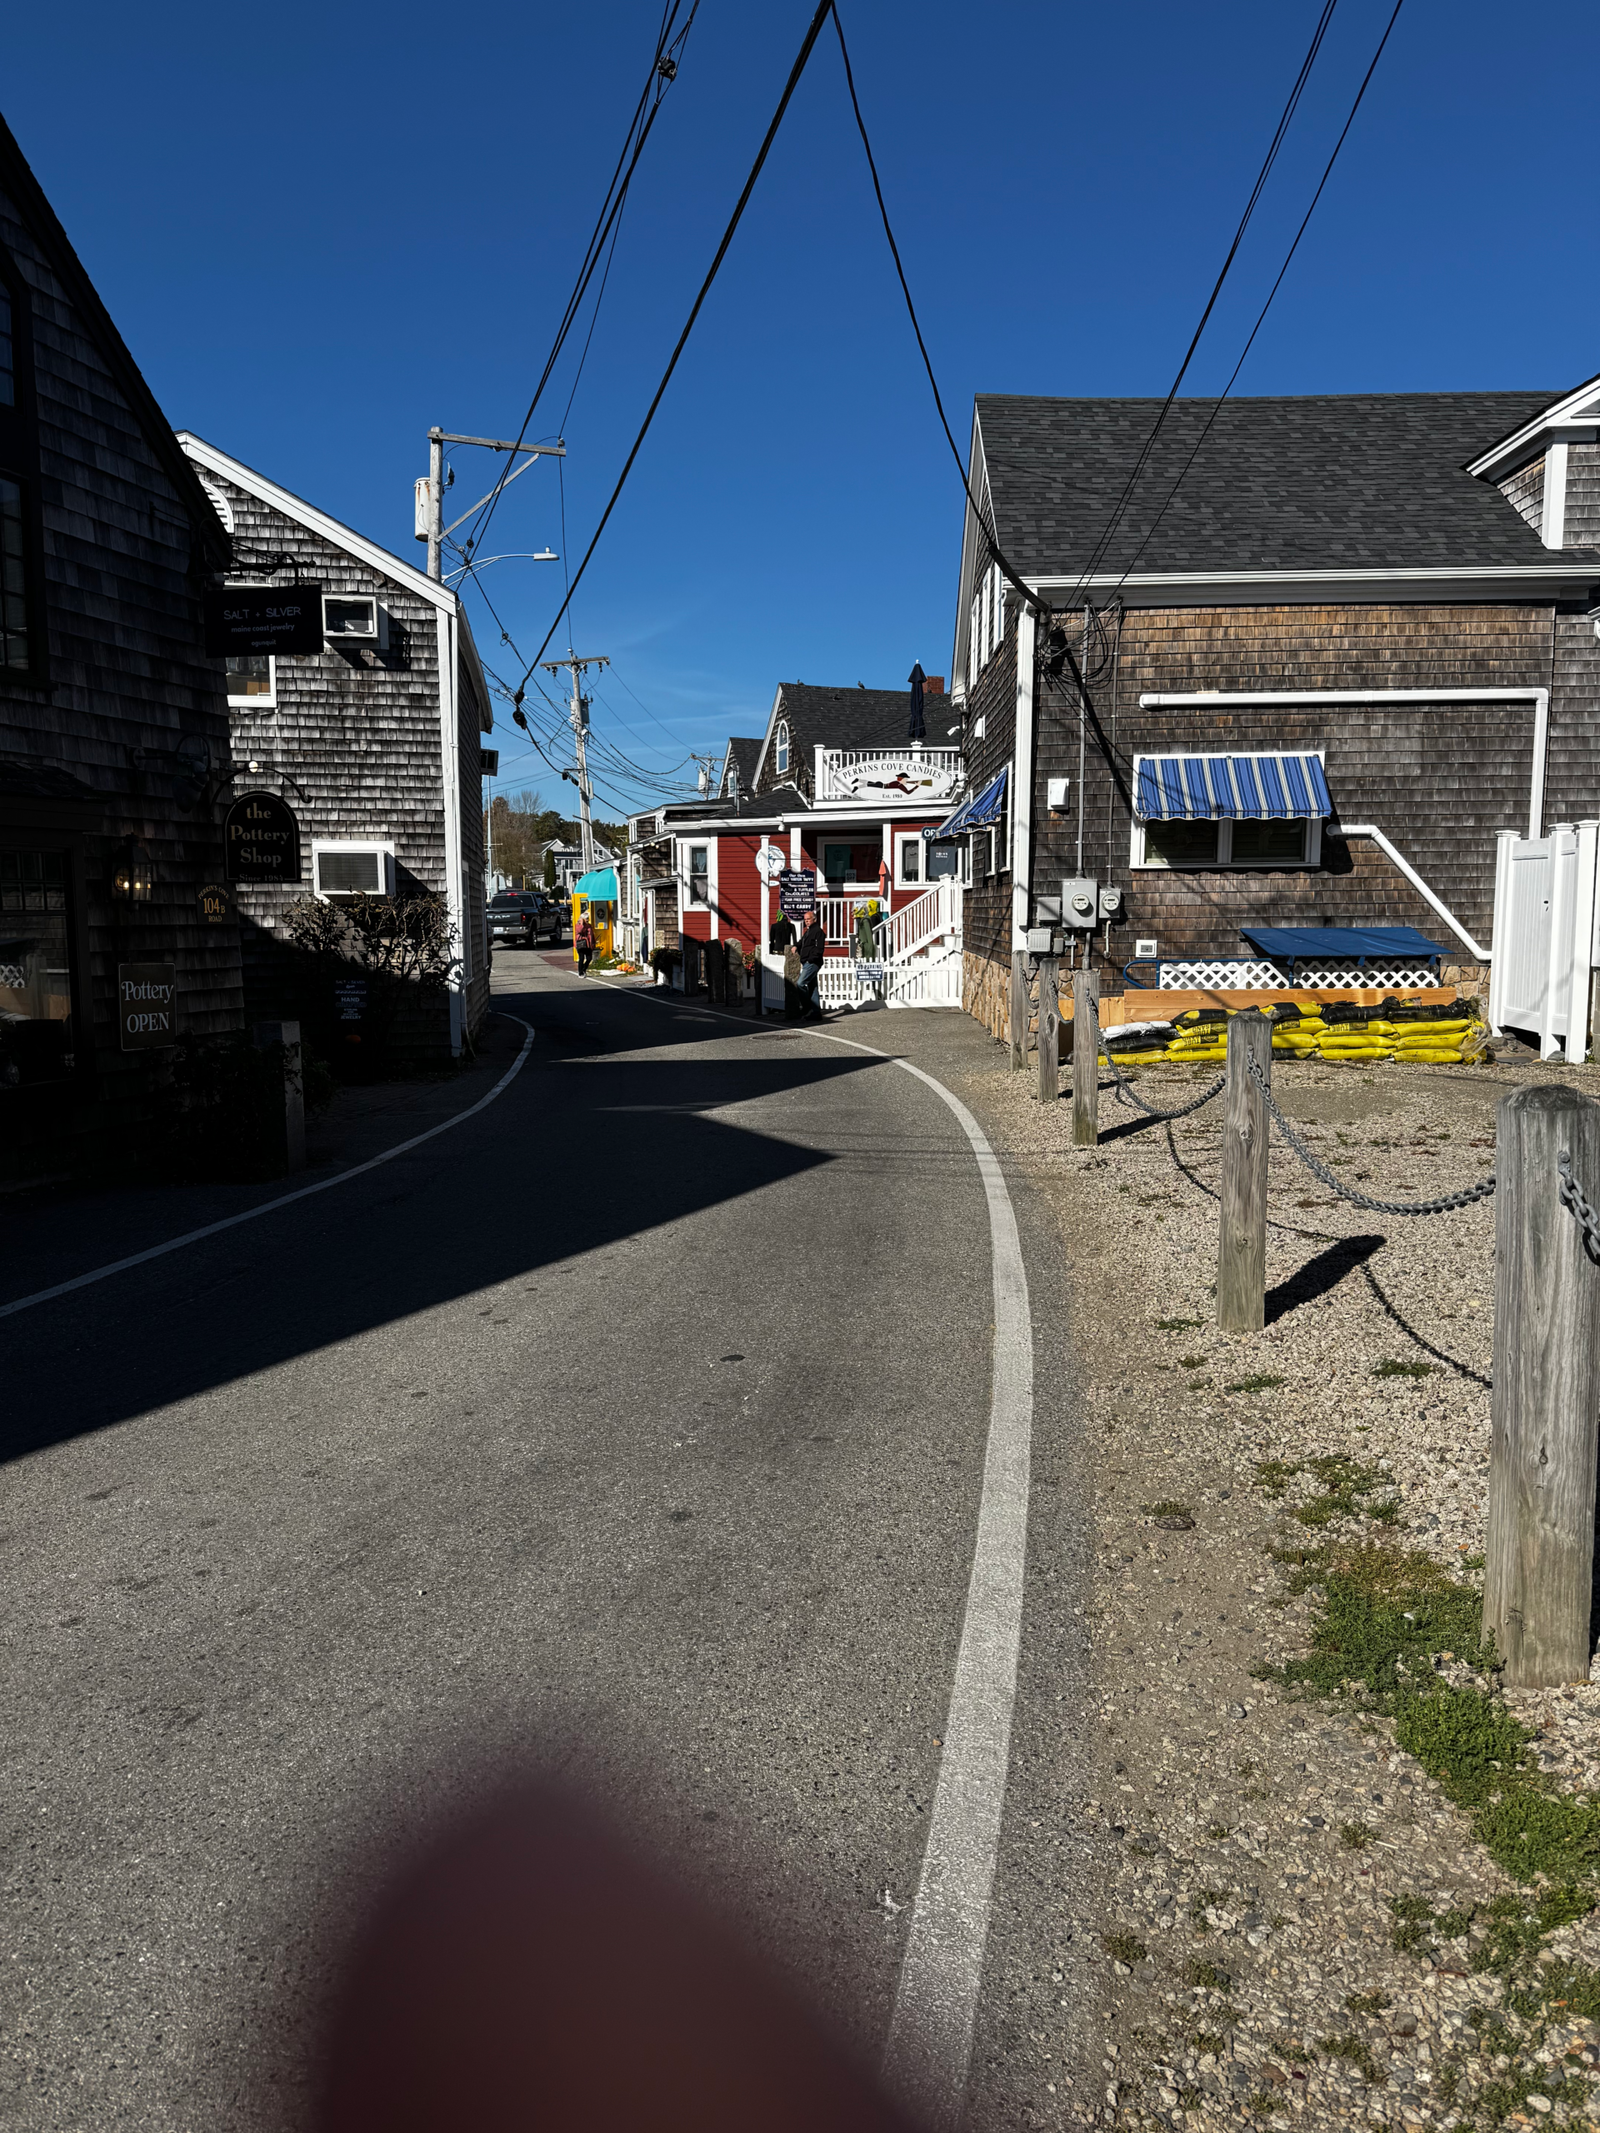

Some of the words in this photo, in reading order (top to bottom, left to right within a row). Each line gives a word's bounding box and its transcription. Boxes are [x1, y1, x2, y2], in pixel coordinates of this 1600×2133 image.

[223, 608, 250, 620] SALT
[265, 605, 302, 618] SILVER
[231, 625, 251, 633] maine
[252, 624, 270, 632] coast
[270, 622, 295, 633] jewelry
[251, 639, 277, 648] ogunquit
[842, 764, 879, 779] PERKINS
[881, 763, 904, 771] COVE
[906, 764, 943, 779] CANDIES
[246, 802, 272, 819] the
[230, 824, 291, 845] Pottery
[239, 846, 282, 868] Shop
[239, 873, 261, 882] Since
[208, 915, 223, 923] ROAD
[121, 980, 174, 1004] Pottery
[126, 1012, 170, 1033] OPEN
